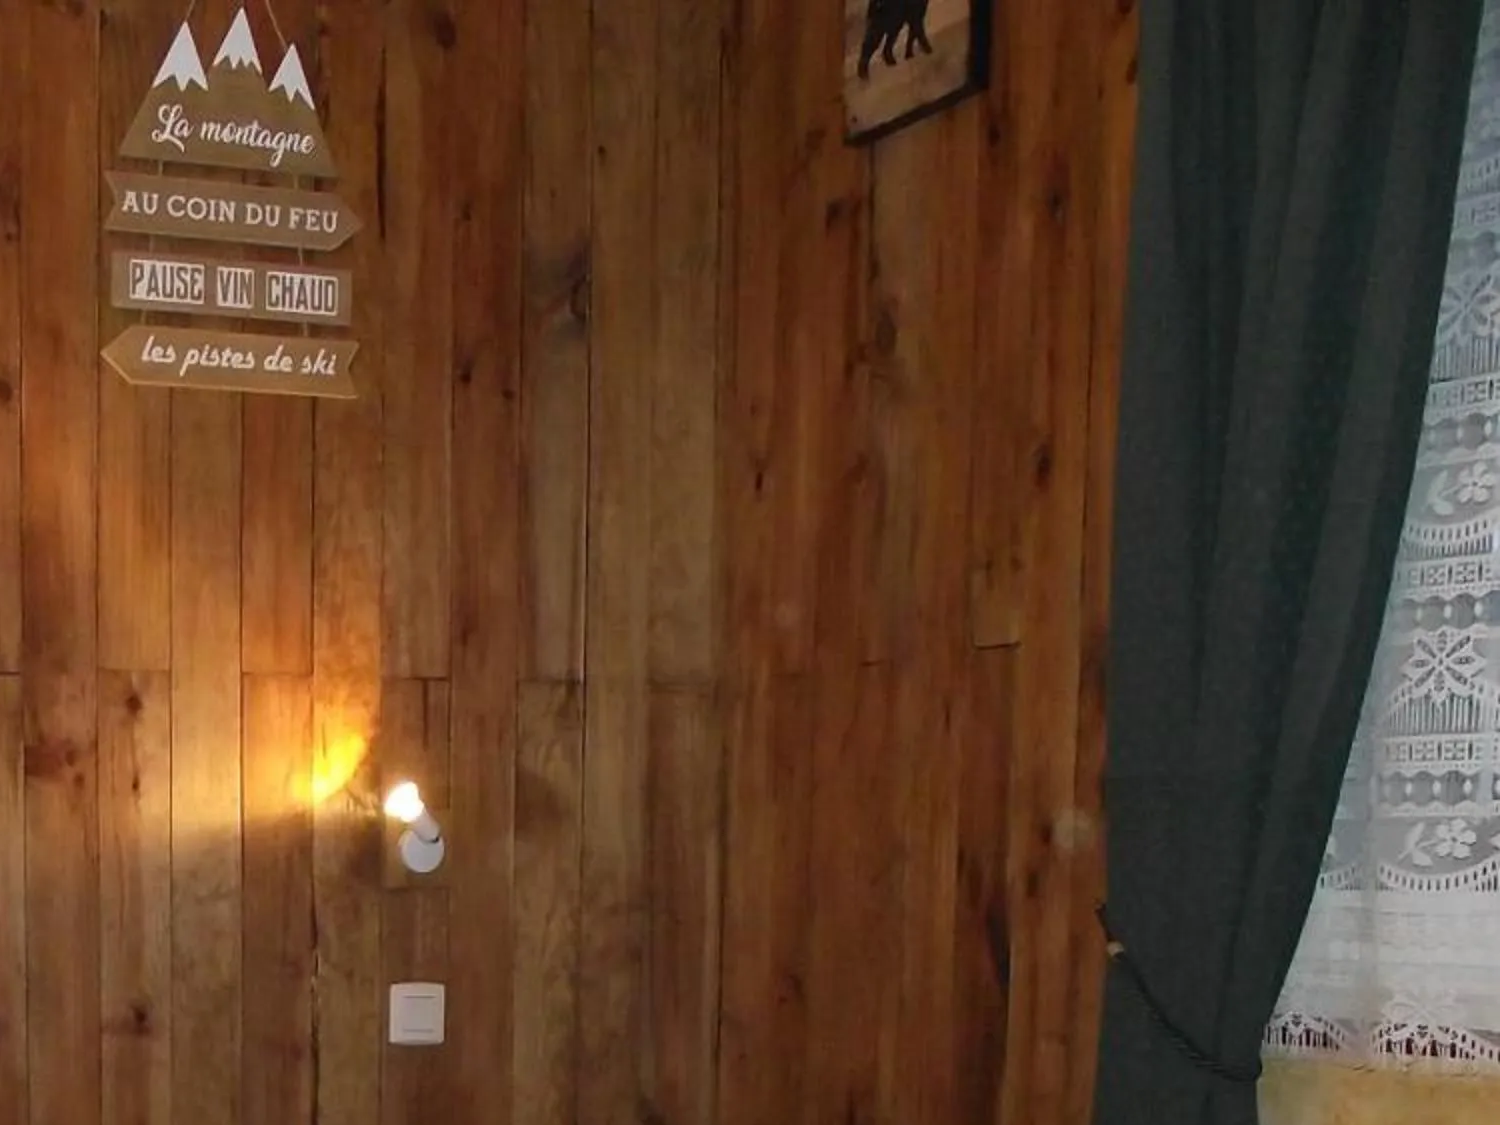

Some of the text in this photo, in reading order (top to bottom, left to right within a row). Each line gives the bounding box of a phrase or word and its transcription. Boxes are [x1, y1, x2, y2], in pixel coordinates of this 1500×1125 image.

[151, 103, 316, 168] La montagne
[121, 191, 339, 233] AU COIN DU FEU
[129, 259, 339, 316] PAUSE VIN CHAUD
[141, 335, 337, 377] les pistes de ski
